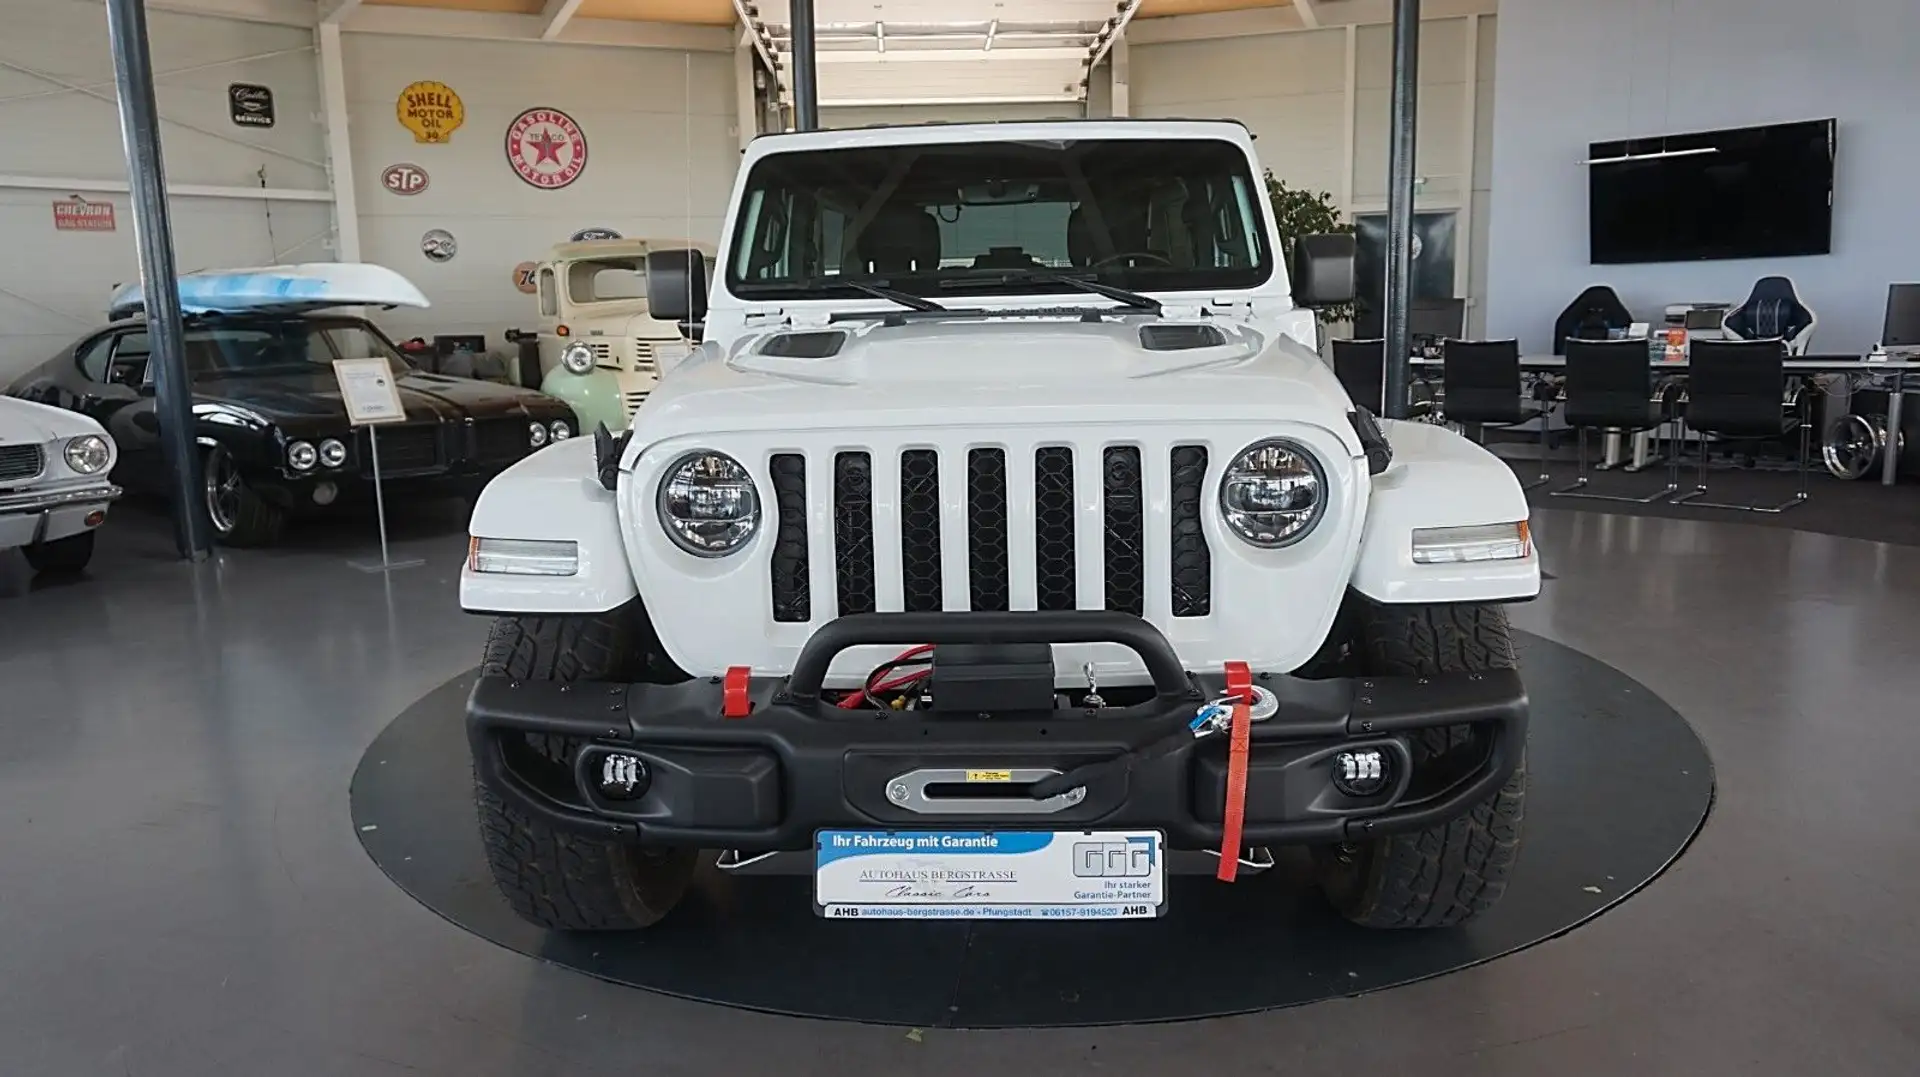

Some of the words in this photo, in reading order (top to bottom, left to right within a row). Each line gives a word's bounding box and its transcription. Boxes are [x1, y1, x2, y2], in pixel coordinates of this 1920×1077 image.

[407, 92, 452, 109] SHELL
[235, 114, 271, 124] SERVICE
[407, 108, 453, 119] MOTOR
[421, 119, 442, 128] OIL
[512, 112, 580, 140] GASOLINE
[530, 133, 564, 141] TEXCO
[513, 154, 562, 184] MOTOR
[565, 157, 582, 177] OIL
[388, 168, 422, 189] STP
[56, 204, 111, 216] CHEVRON
[832, 835, 852, 848] Ihr
[854, 835, 914, 849] Fahrzeug
[917, 836, 939, 848] mit
[941, 836, 999, 848] Garantie
[860, 870, 928, 880] AUTOHAUS
[931, 870, 1017, 879] BERGSTRASSE
[1104, 881, 1117, 889] Ihr
[1119, 881, 1151, 889] starker
[884, 885, 944, 899] Classic
[953, 885, 990, 898] Cars
[1073, 891, 1152, 900] Garantie-Partner
[834, 907, 859, 917] AHB
[861, 907, 974, 917] autohaus-bergstrasse.de
[982, 908, 1032, 917] Pfungstadt
[1050, 908, 1118, 917] 06157-9194520
[1122, 906, 1148, 916] AHB
